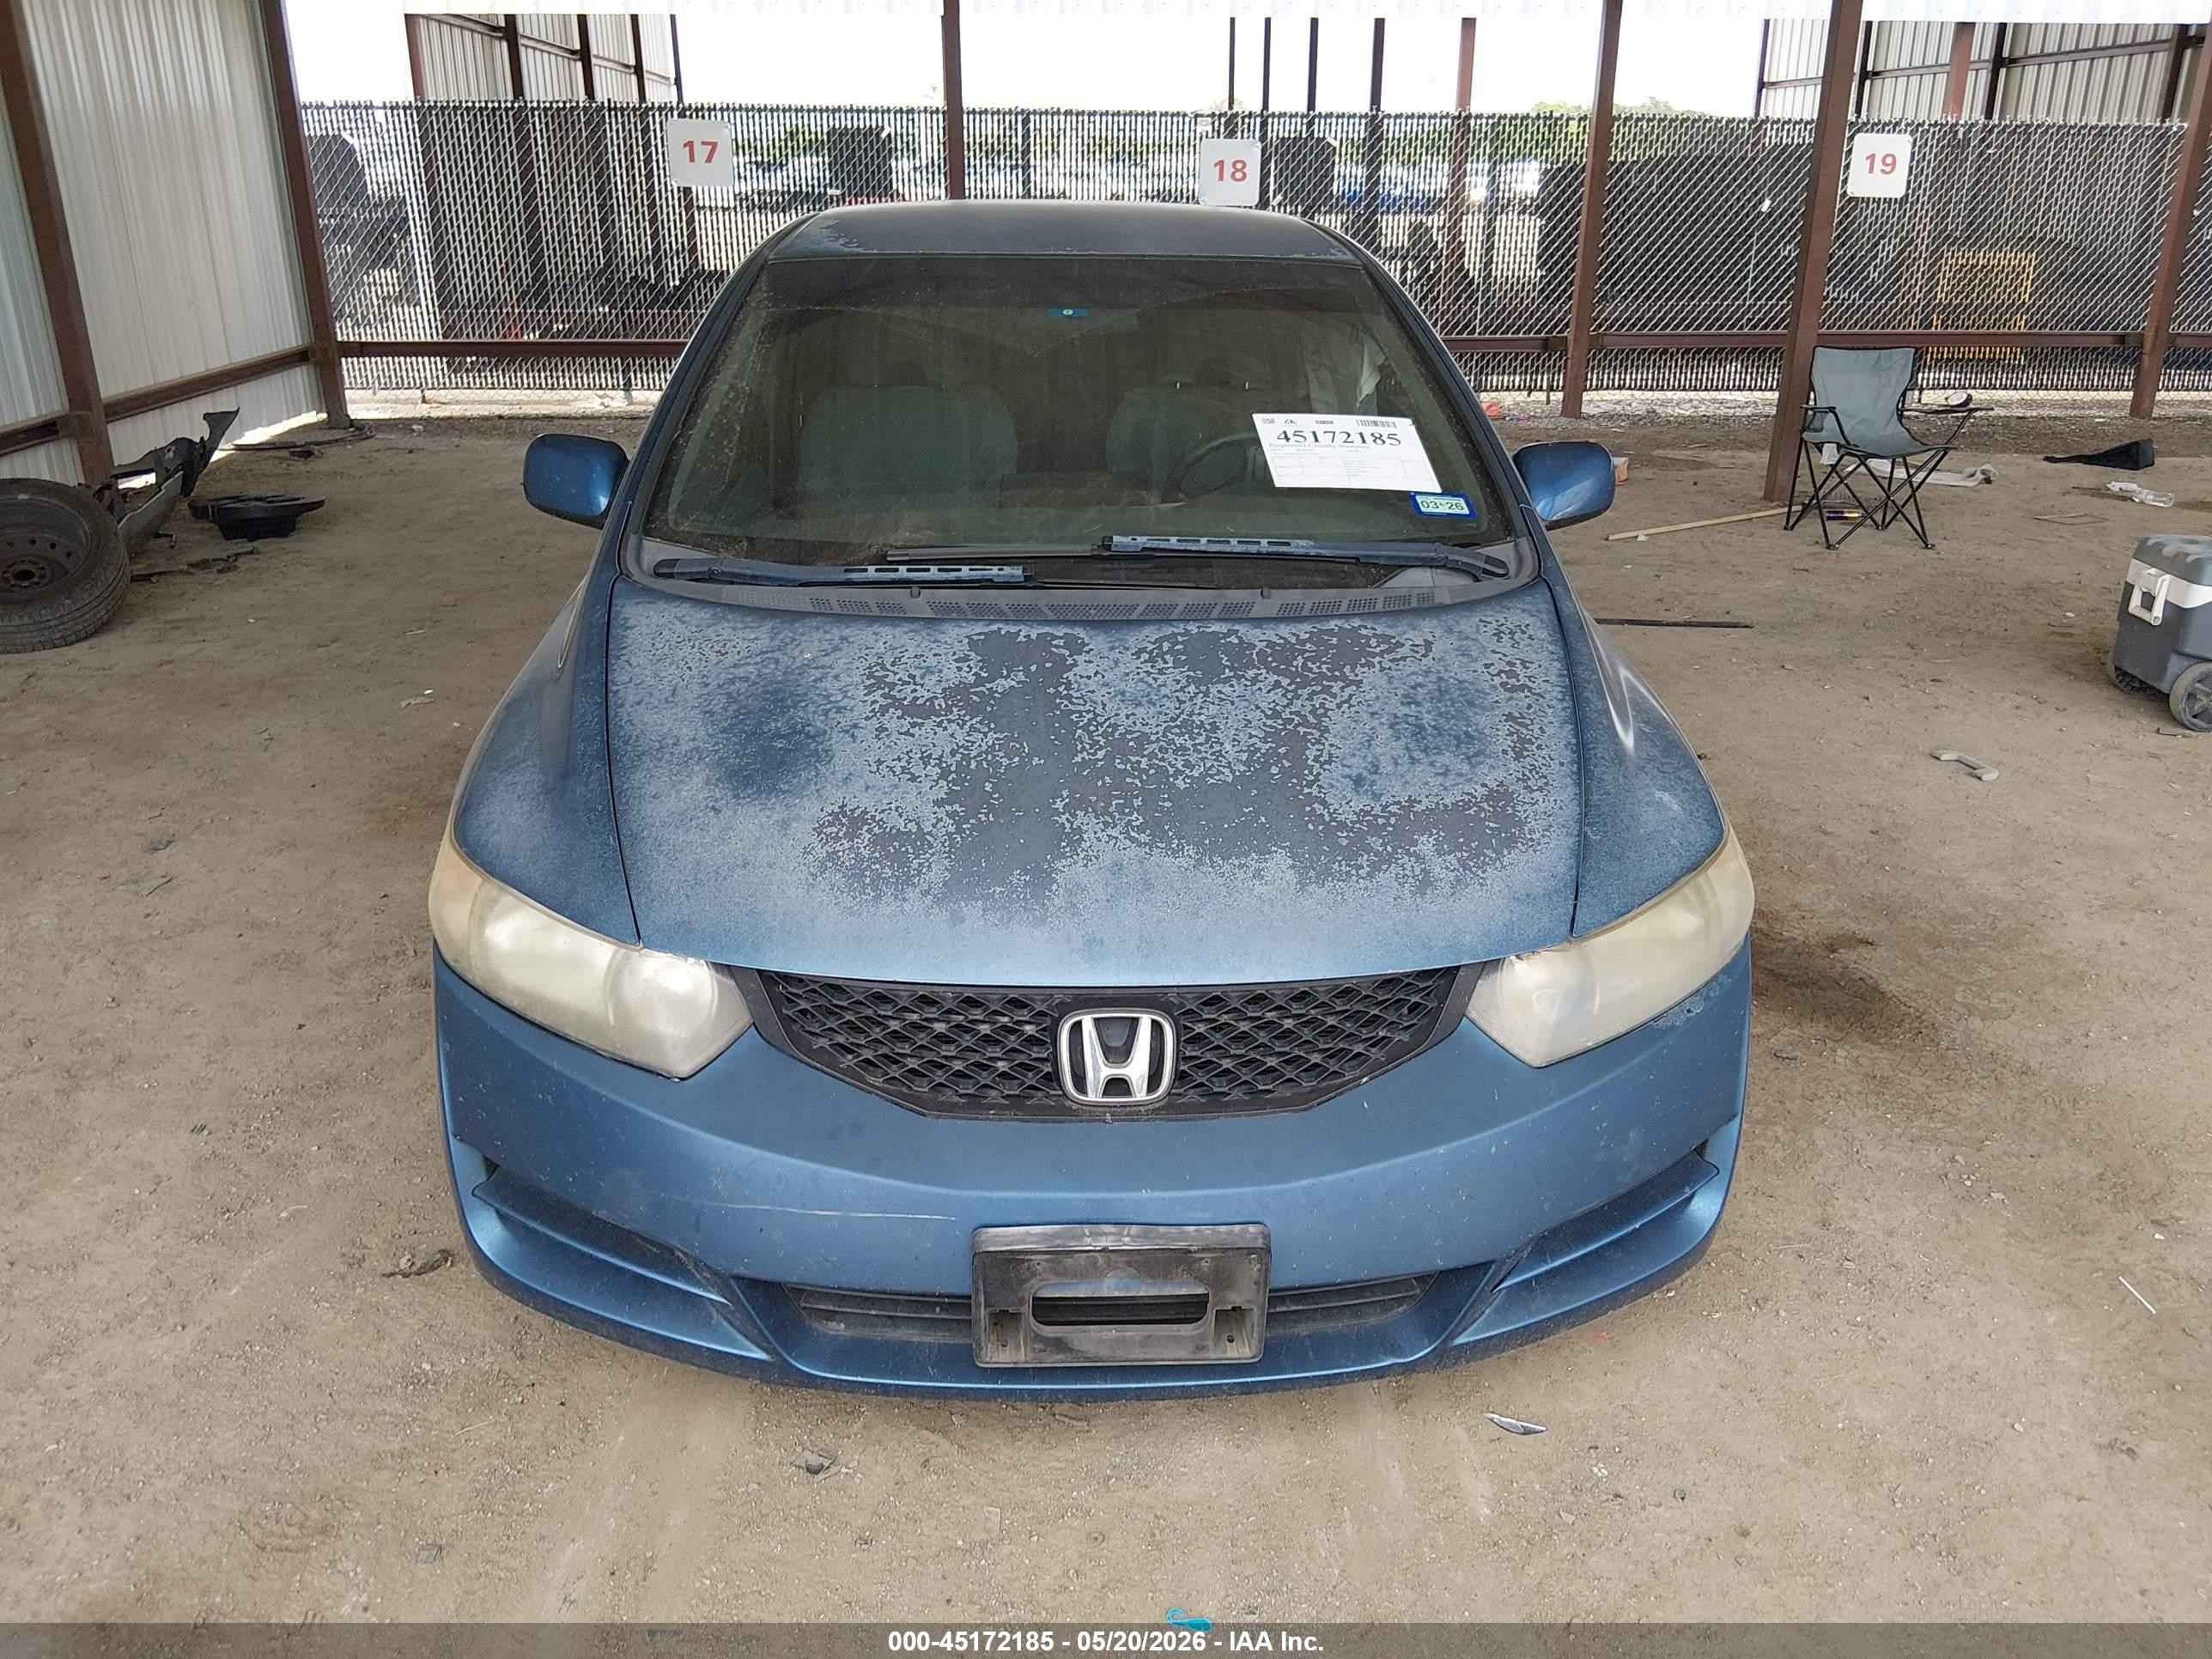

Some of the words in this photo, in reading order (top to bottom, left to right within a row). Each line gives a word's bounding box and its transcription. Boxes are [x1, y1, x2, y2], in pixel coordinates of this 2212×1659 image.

[682, 141, 718, 162] 17
[1213, 160, 1247, 182] 18
[1864, 153, 1897, 175] 19
[1277, 430, 1401, 446] 45172185
[1420, 500, 1439, 509] 03
[1446, 501, 1464, 511] 26
